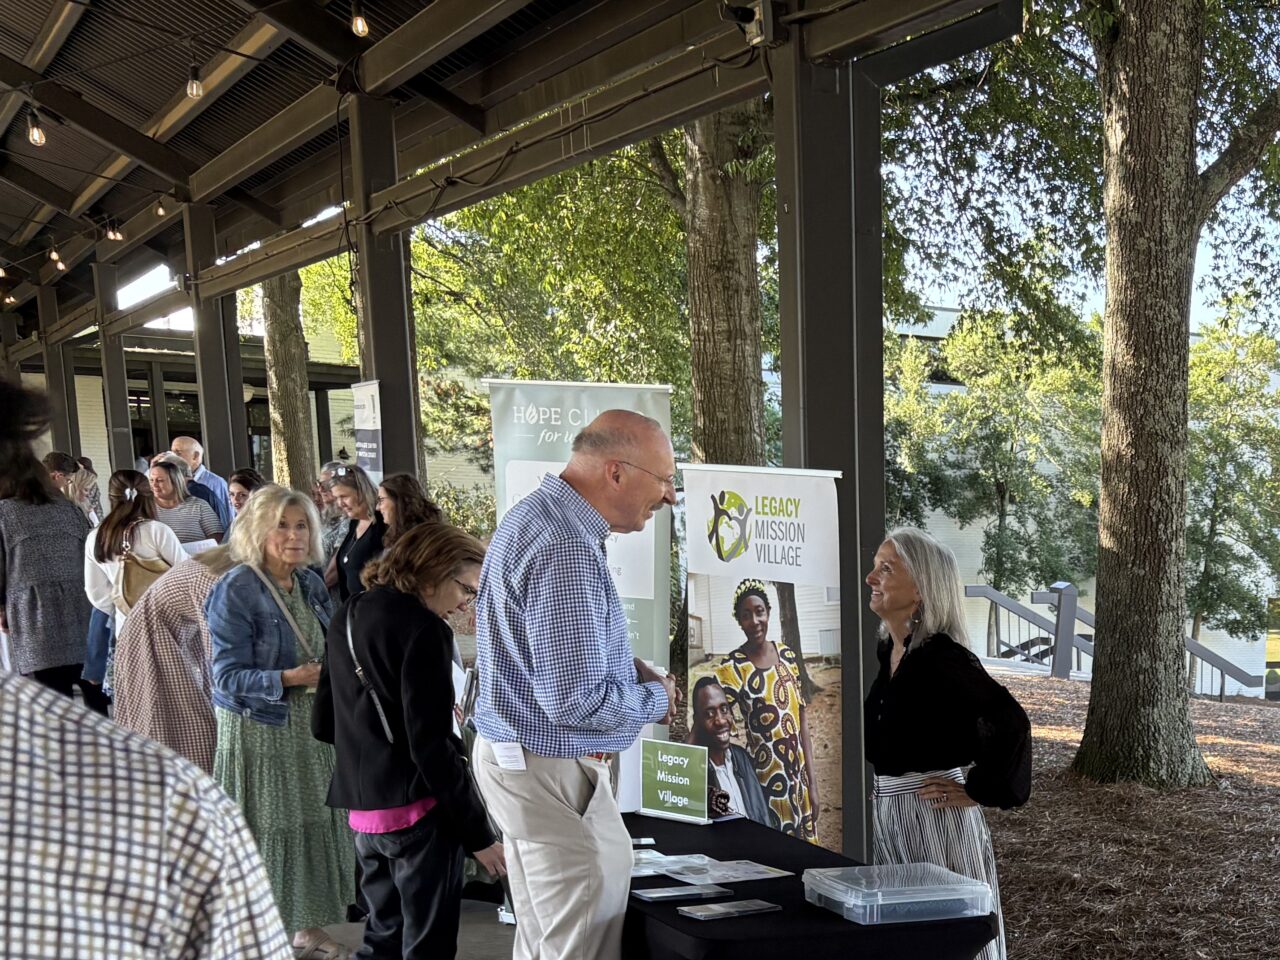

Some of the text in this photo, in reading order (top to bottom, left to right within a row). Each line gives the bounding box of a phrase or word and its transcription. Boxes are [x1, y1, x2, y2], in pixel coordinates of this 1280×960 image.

[537, 428, 562, 446] for
[755, 495, 801, 519] LEGACY
[755, 519, 805, 543] MISSION
[755, 543, 802, 567] VILLAGE
[658, 750, 689, 768] Legacy
[657, 770, 690, 785] Mission
[658, 789, 689, 807] Village
